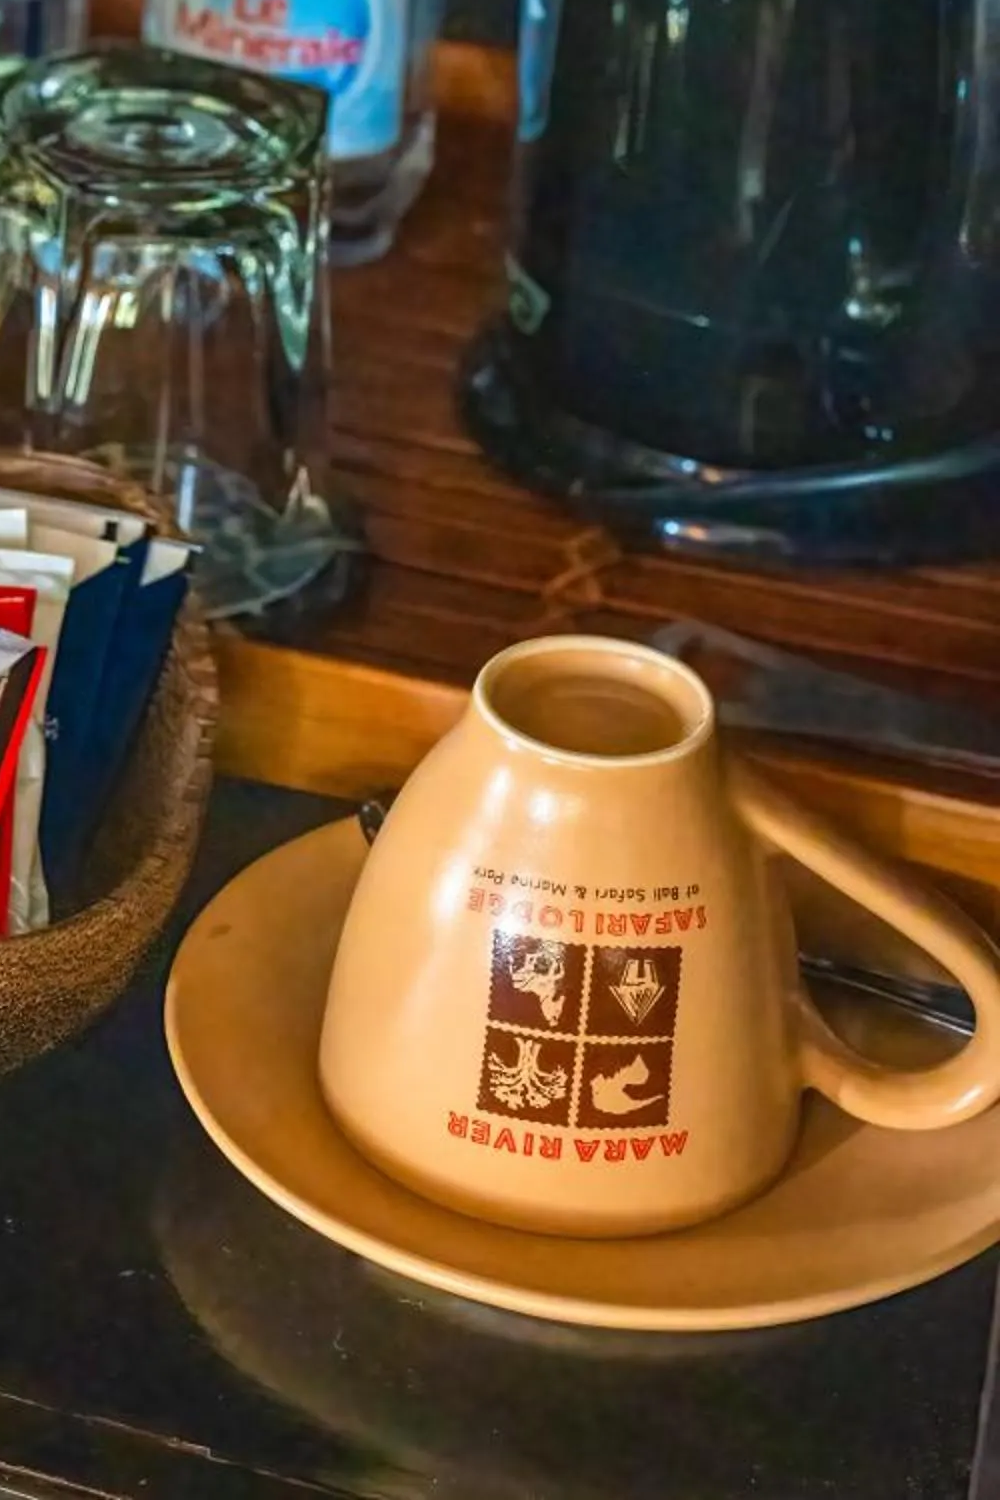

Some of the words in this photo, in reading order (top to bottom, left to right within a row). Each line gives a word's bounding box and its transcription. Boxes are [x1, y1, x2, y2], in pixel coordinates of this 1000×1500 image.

[511, 874, 566, 898] Marine
[574, 885, 586, 899] &
[595, 887, 645, 903] Safari
[653, 886, 679, 901] Bali
[684, 884, 700, 897] at
[465, 886, 584, 931] LODGE
[596, 905, 707, 937] SAFARI
[446, 1111, 562, 1162] RIVER
[574, 1130, 689, 1163] MARA
